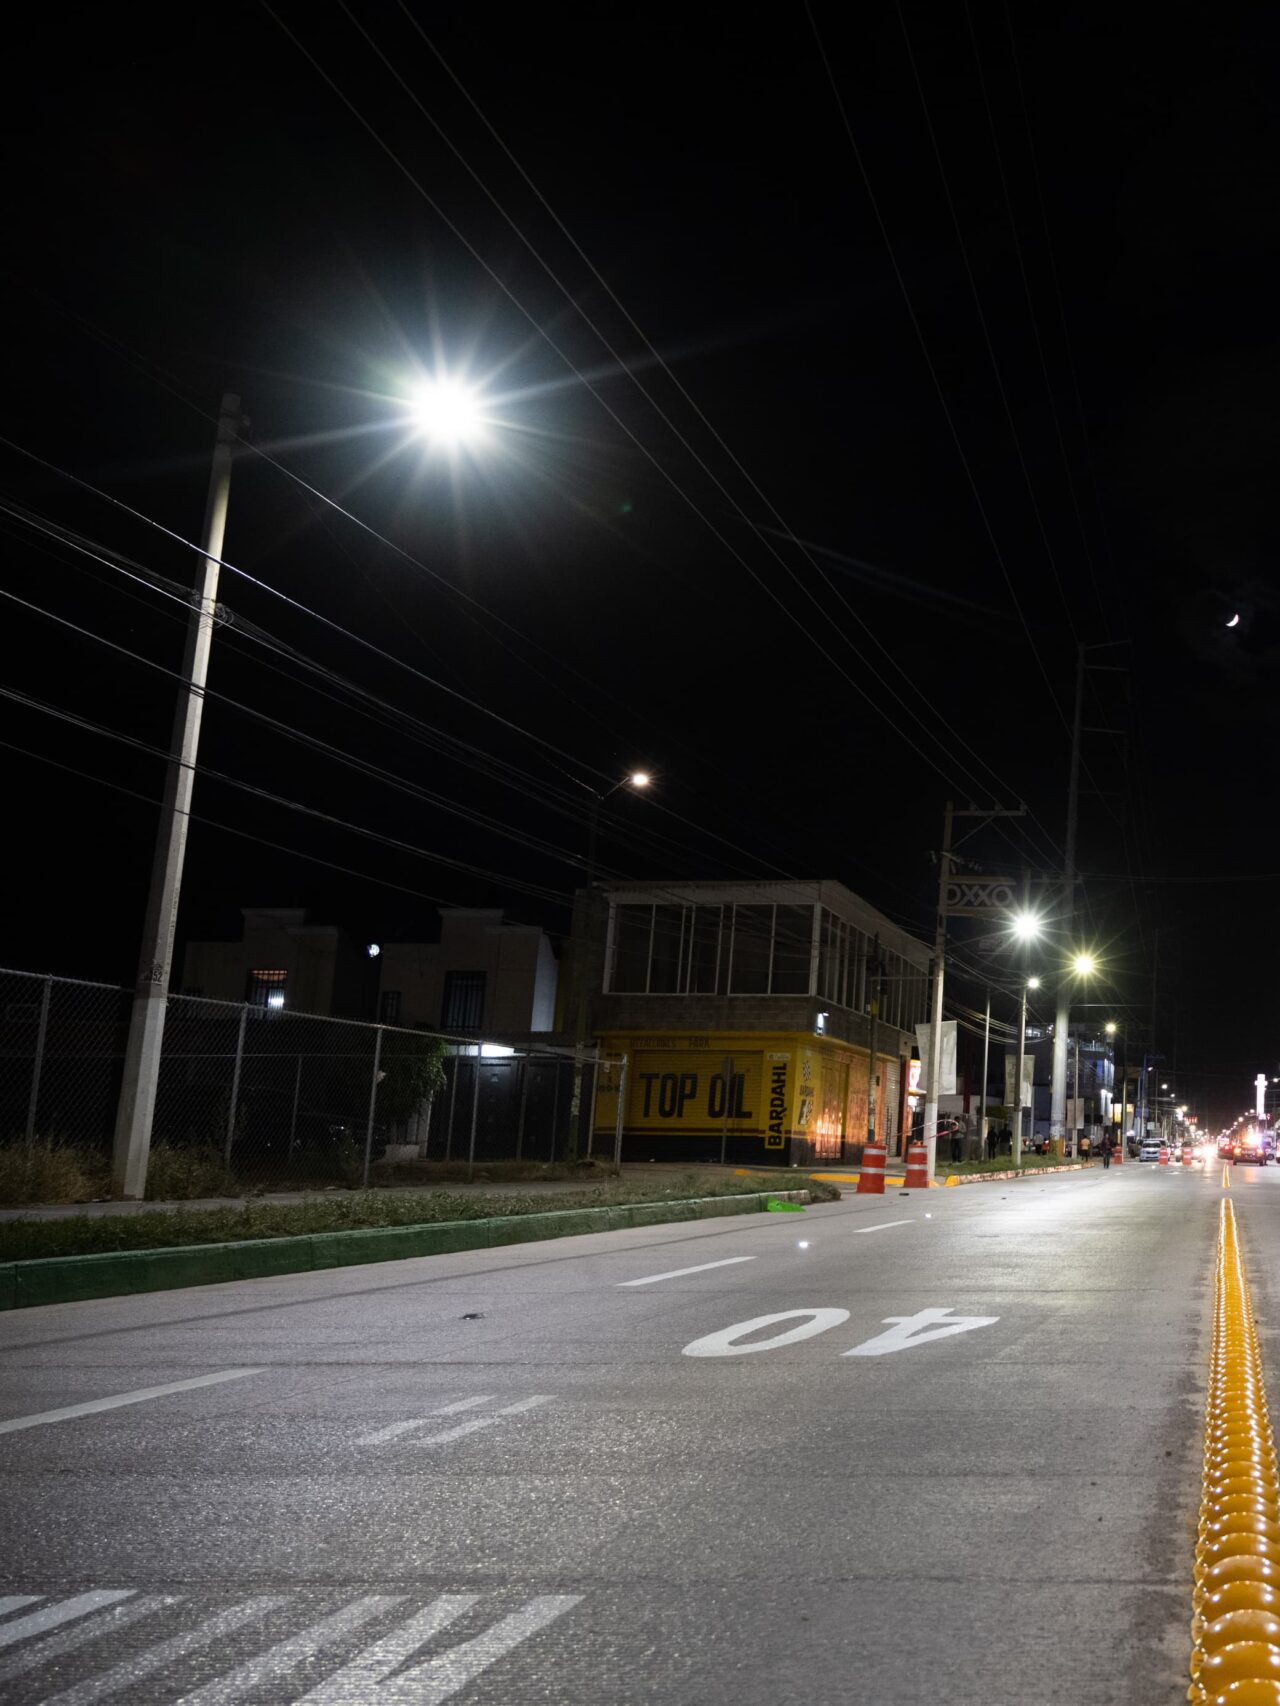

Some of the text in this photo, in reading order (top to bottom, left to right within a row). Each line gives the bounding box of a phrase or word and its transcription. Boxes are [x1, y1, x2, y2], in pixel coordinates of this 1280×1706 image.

[947, 884, 1013, 907] OXXO
[639, 1073, 753, 1119] TOP OIL
[766, 1062, 788, 1148] BARDAHL
